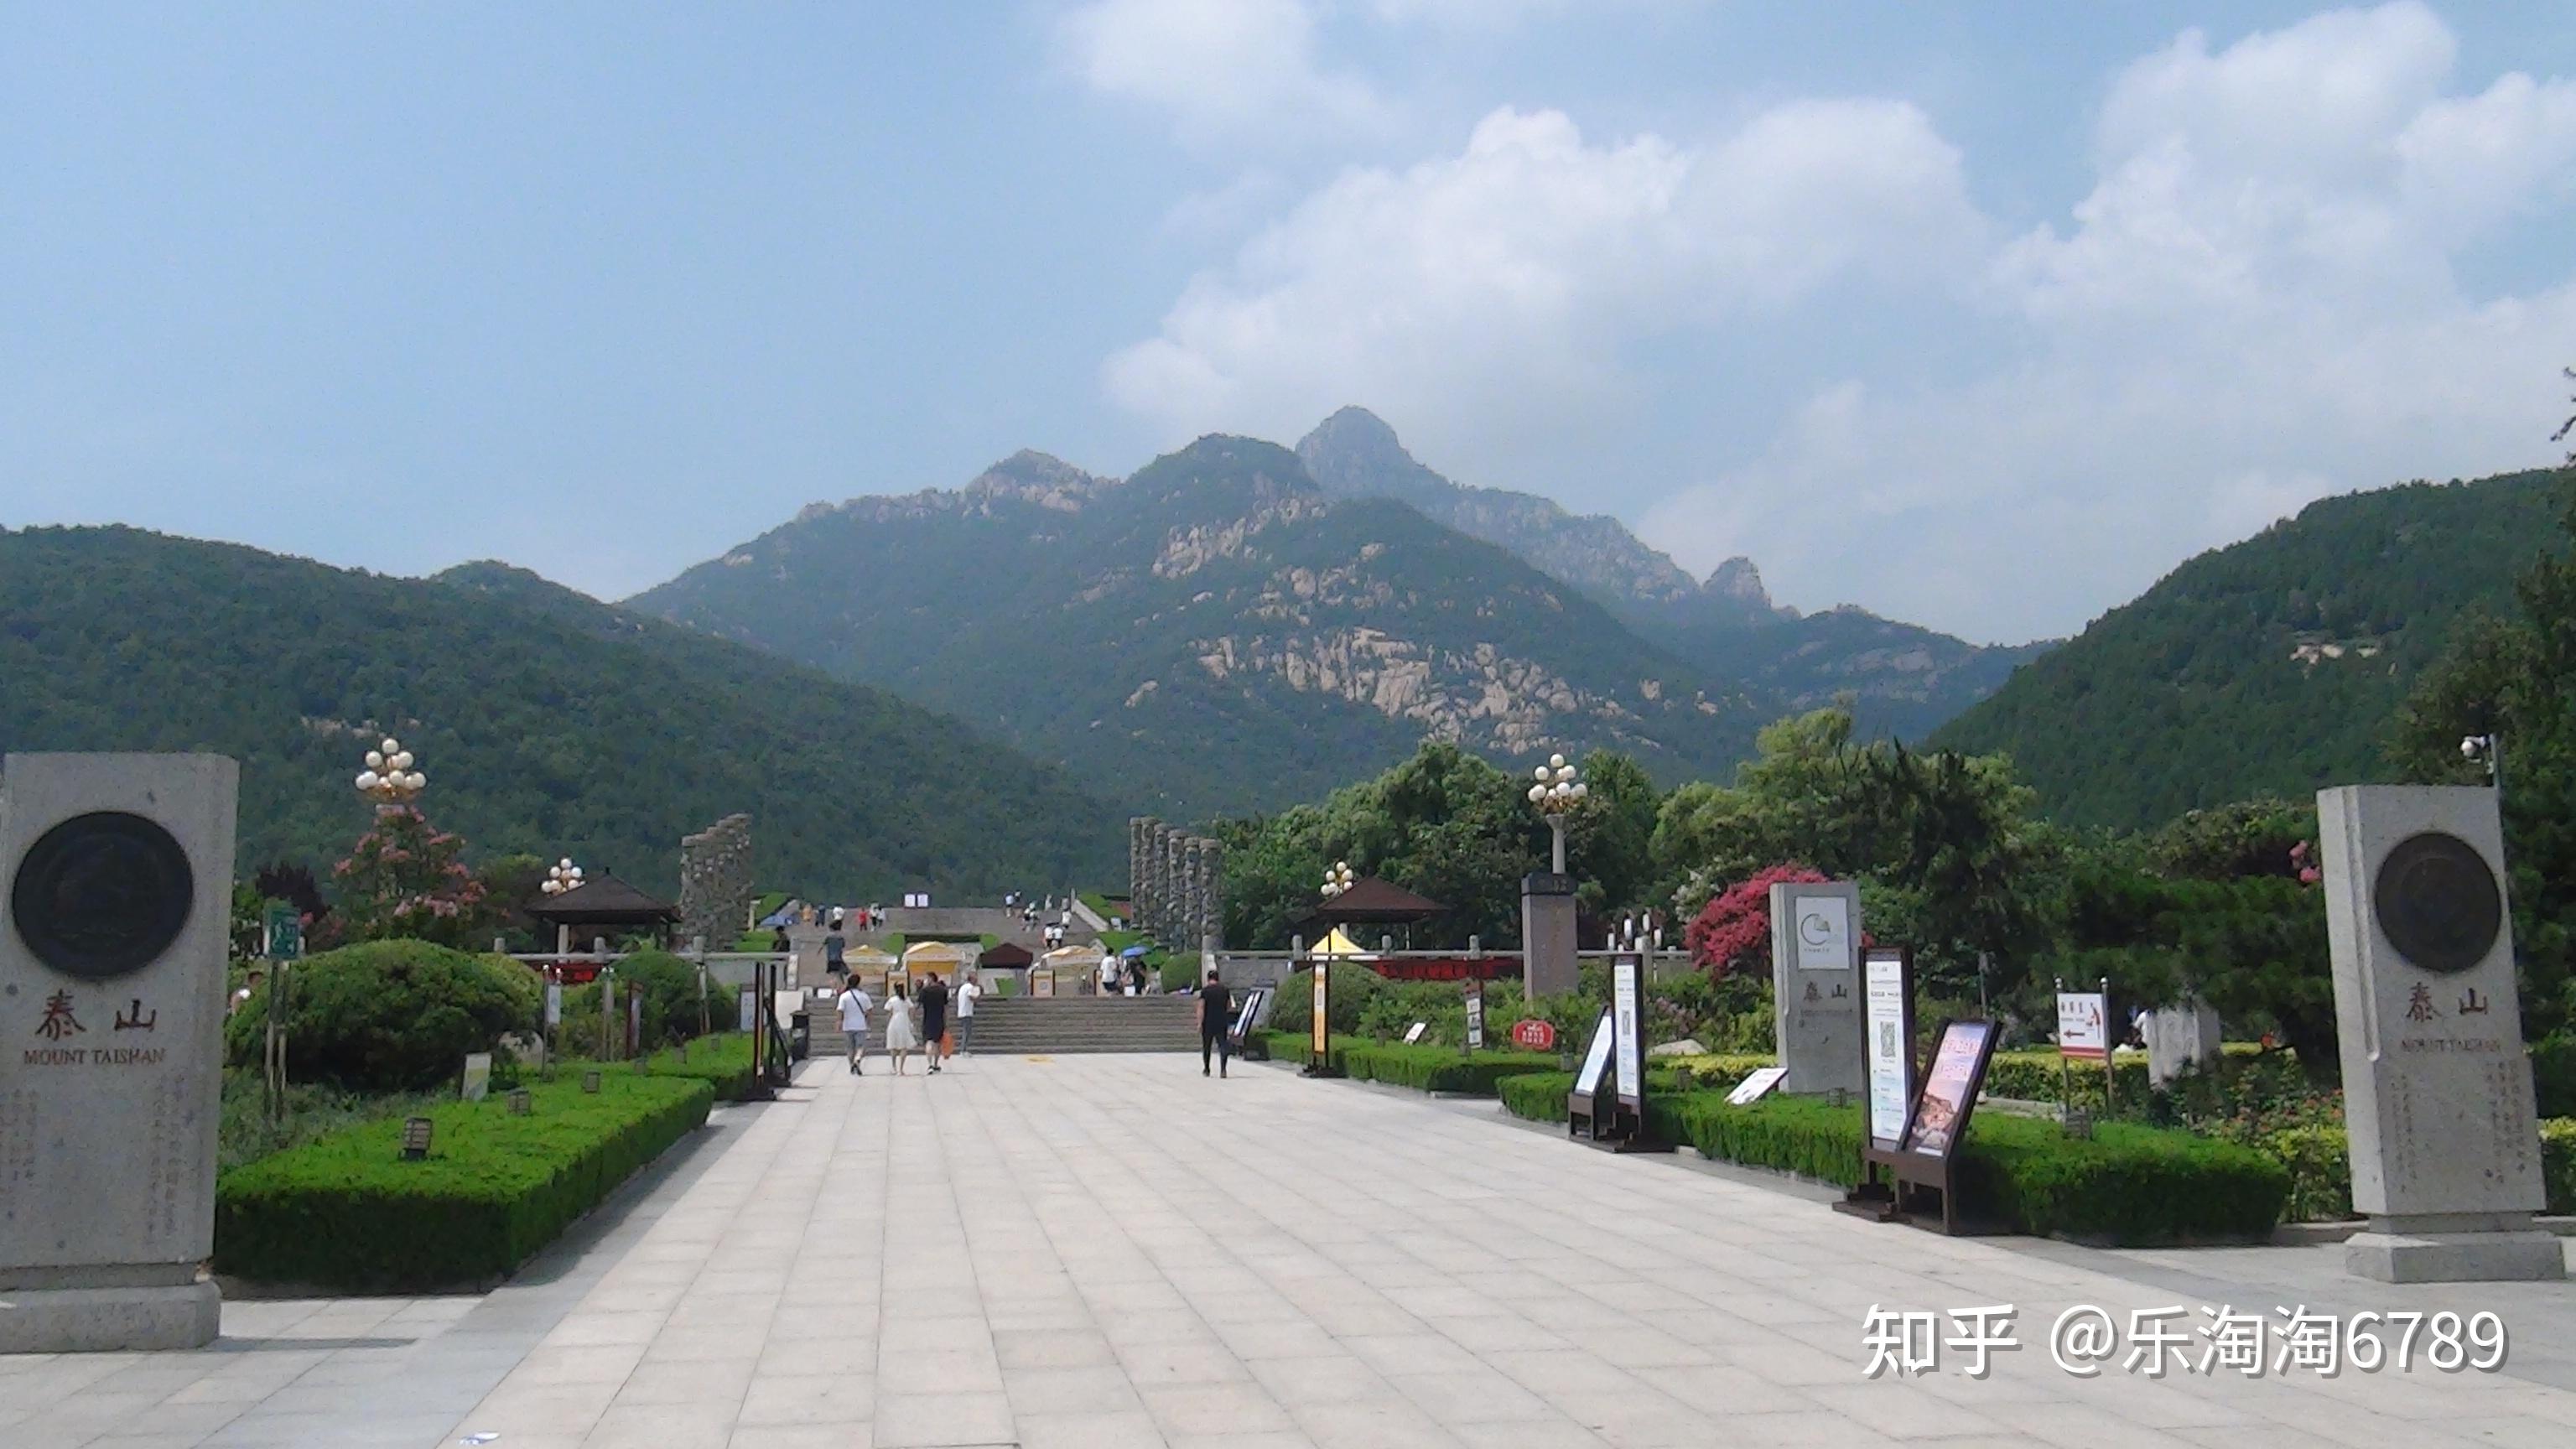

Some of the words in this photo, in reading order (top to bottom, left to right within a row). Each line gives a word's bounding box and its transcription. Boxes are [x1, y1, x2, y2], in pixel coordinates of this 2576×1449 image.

[35, 988, 157, 1041] 泰山
[2406, 981, 2488, 1022] 泰山
[24, 1049, 88, 1065] MOUNT
[92, 1047, 166, 1065] TAISHAN
